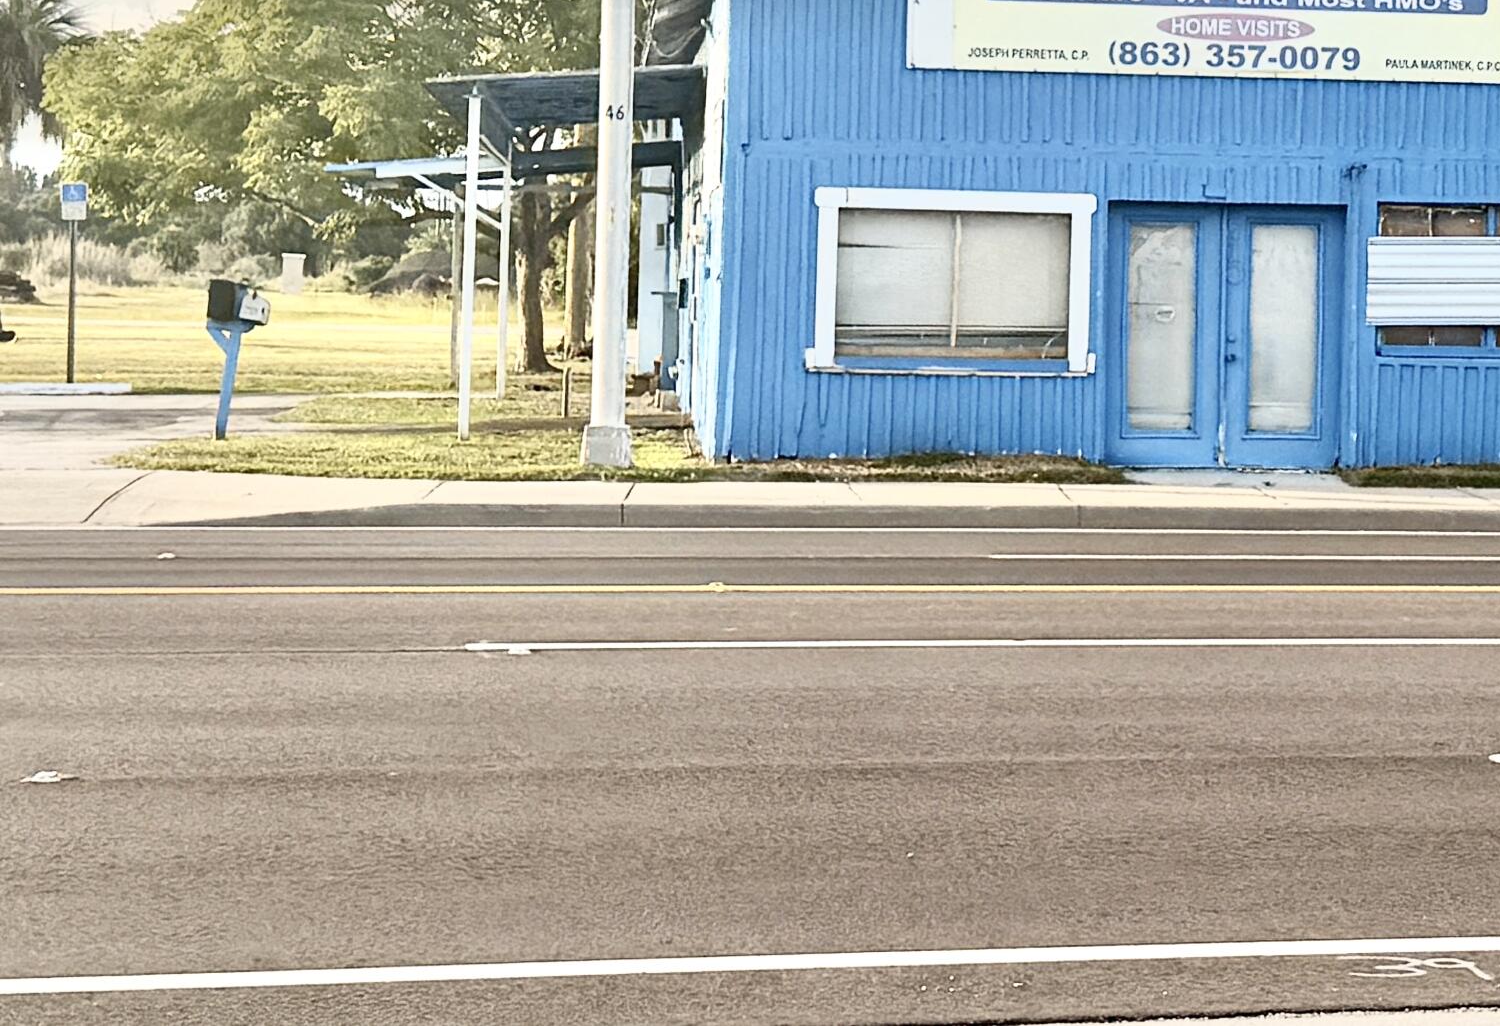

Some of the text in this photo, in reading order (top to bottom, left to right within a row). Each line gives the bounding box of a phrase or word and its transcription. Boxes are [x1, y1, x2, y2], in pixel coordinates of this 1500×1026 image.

[1171, 17, 1301, 38] HOME VISITS
[968, 47, 1009, 58] JOSEPH
[1108, 40, 1361, 72] (863) 357-0079
[1385, 58, 1419, 69] PAULA
[605, 104, 625, 121] 46
